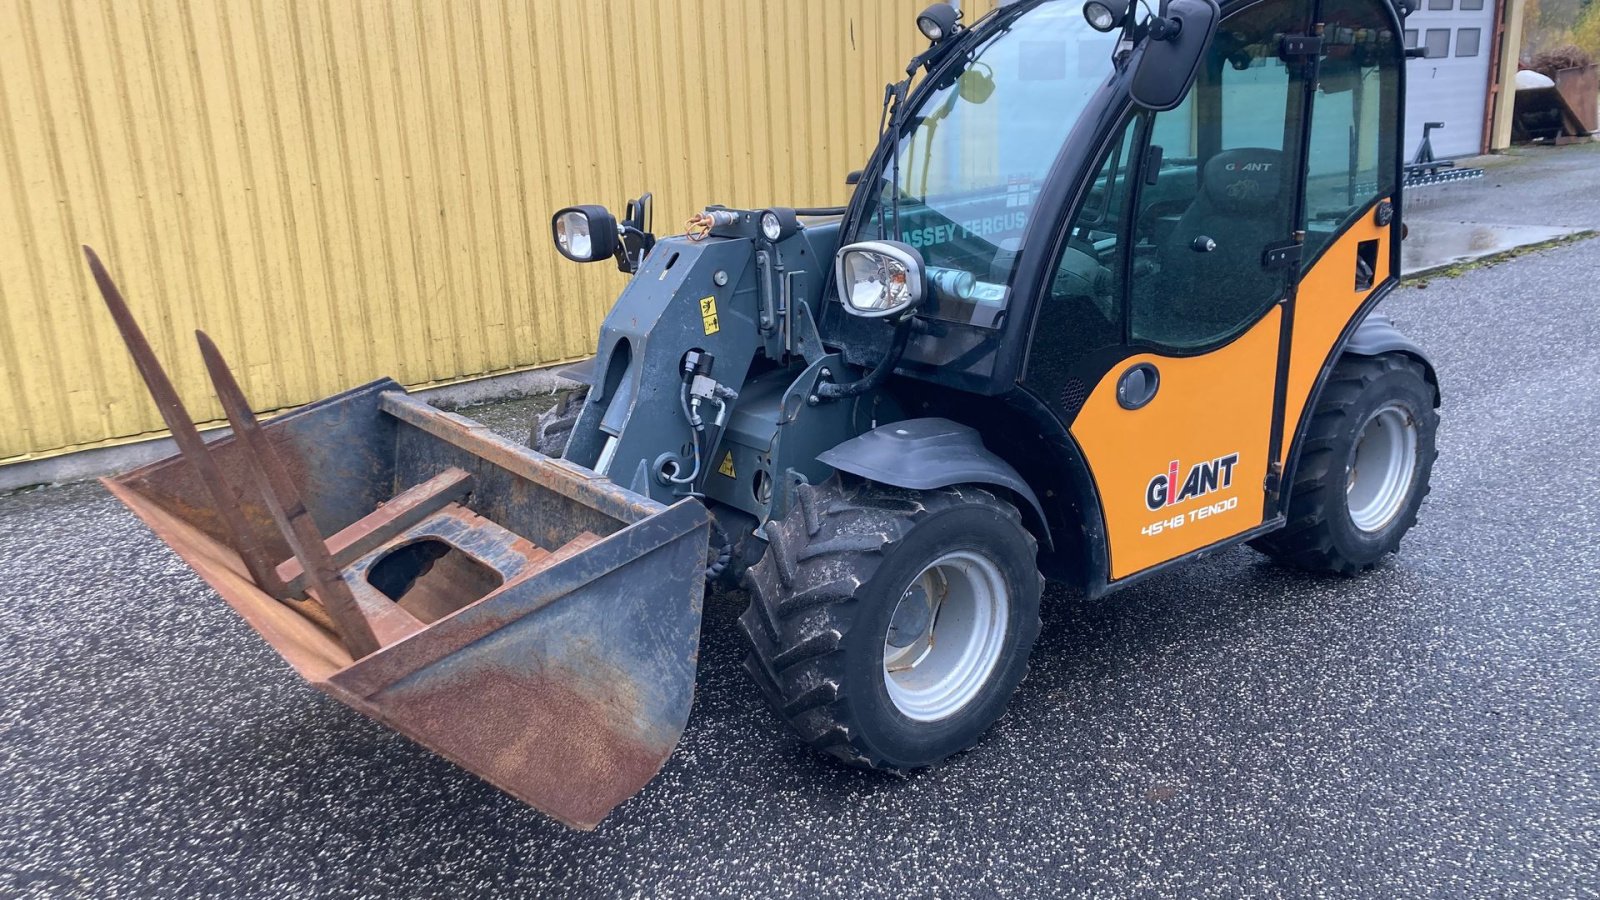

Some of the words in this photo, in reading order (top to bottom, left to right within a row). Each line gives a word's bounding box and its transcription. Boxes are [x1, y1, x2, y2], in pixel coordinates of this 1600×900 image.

[887, 223, 956, 248] ASSEY
[962, 211, 1029, 239] FERGUS
[1141, 514, 1185, 536] 4548
[1188, 497, 1238, 522] TENDO
